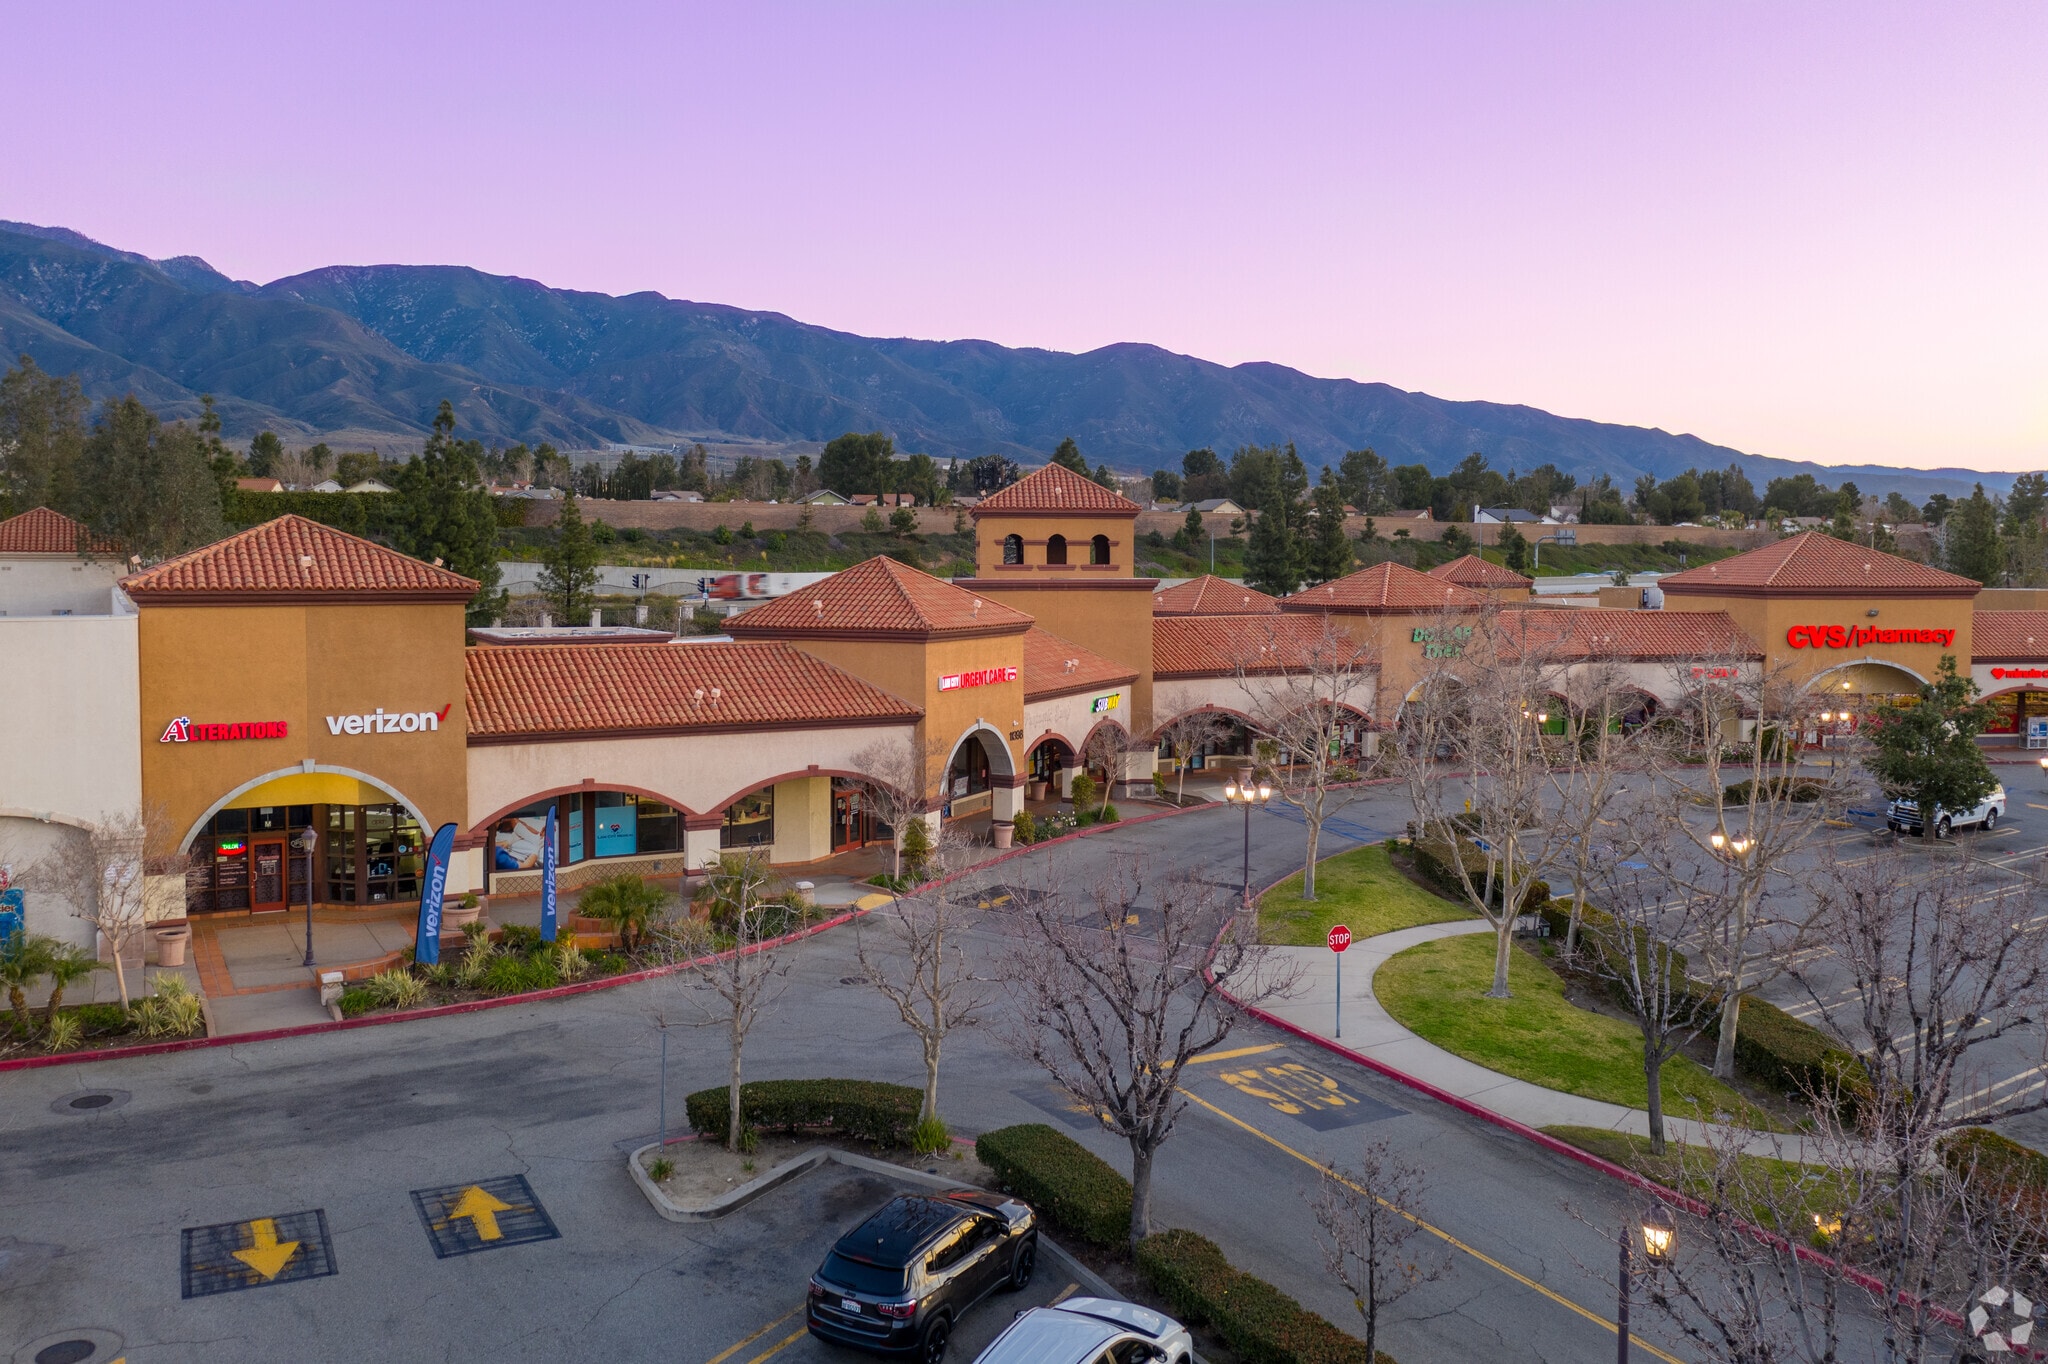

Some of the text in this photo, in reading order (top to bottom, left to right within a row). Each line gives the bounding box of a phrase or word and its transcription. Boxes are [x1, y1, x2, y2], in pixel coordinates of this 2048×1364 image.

[1786, 624, 1955, 649] CVS/pharmacy
[960, 670, 988, 689] URGENT
[989, 667, 1006, 684] CARE
[1096, 695, 1121, 712] SUBWAY
[325, 707, 439, 736] verizon
[545, 846, 556, 916] verizon
[425, 865, 446, 938] verizon
[1329, 933, 1350, 945] STOP
